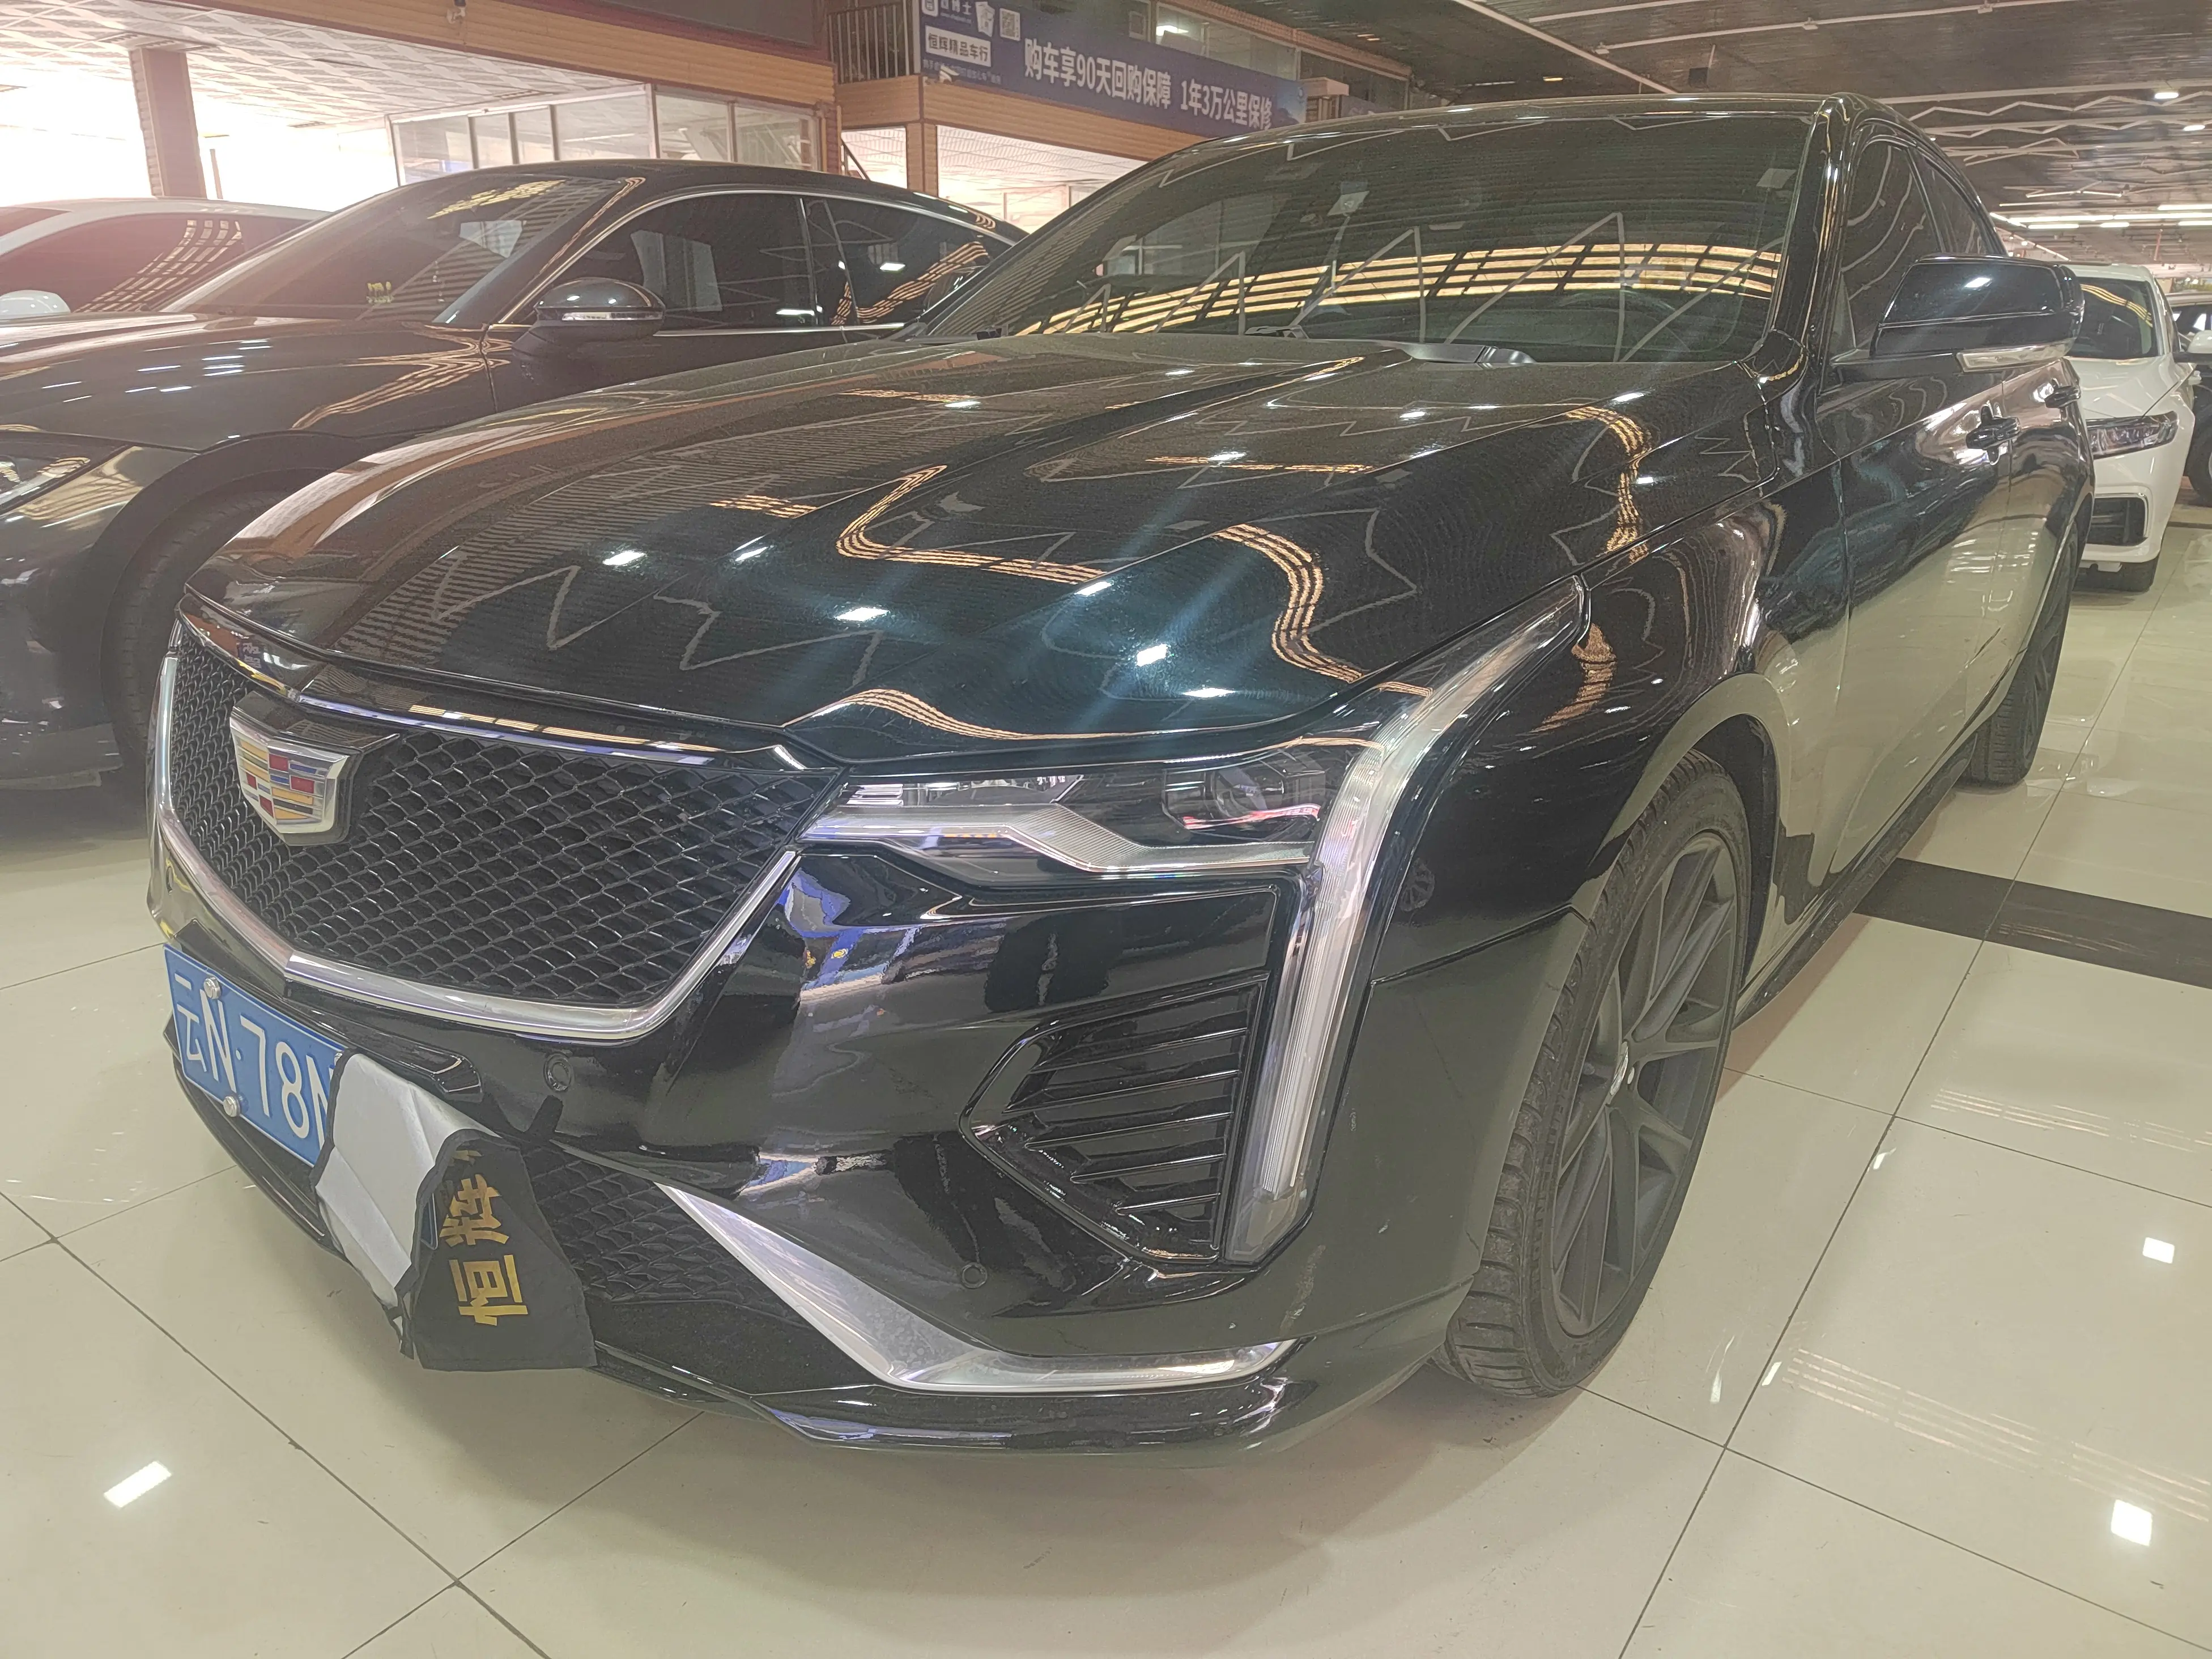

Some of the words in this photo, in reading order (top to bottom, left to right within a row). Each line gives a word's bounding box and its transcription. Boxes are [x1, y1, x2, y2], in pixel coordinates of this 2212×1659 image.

[1025, 38, 1171, 109] 购车享90天回购保障
[1180, 78, 1273, 130] 1年3万公里保修
